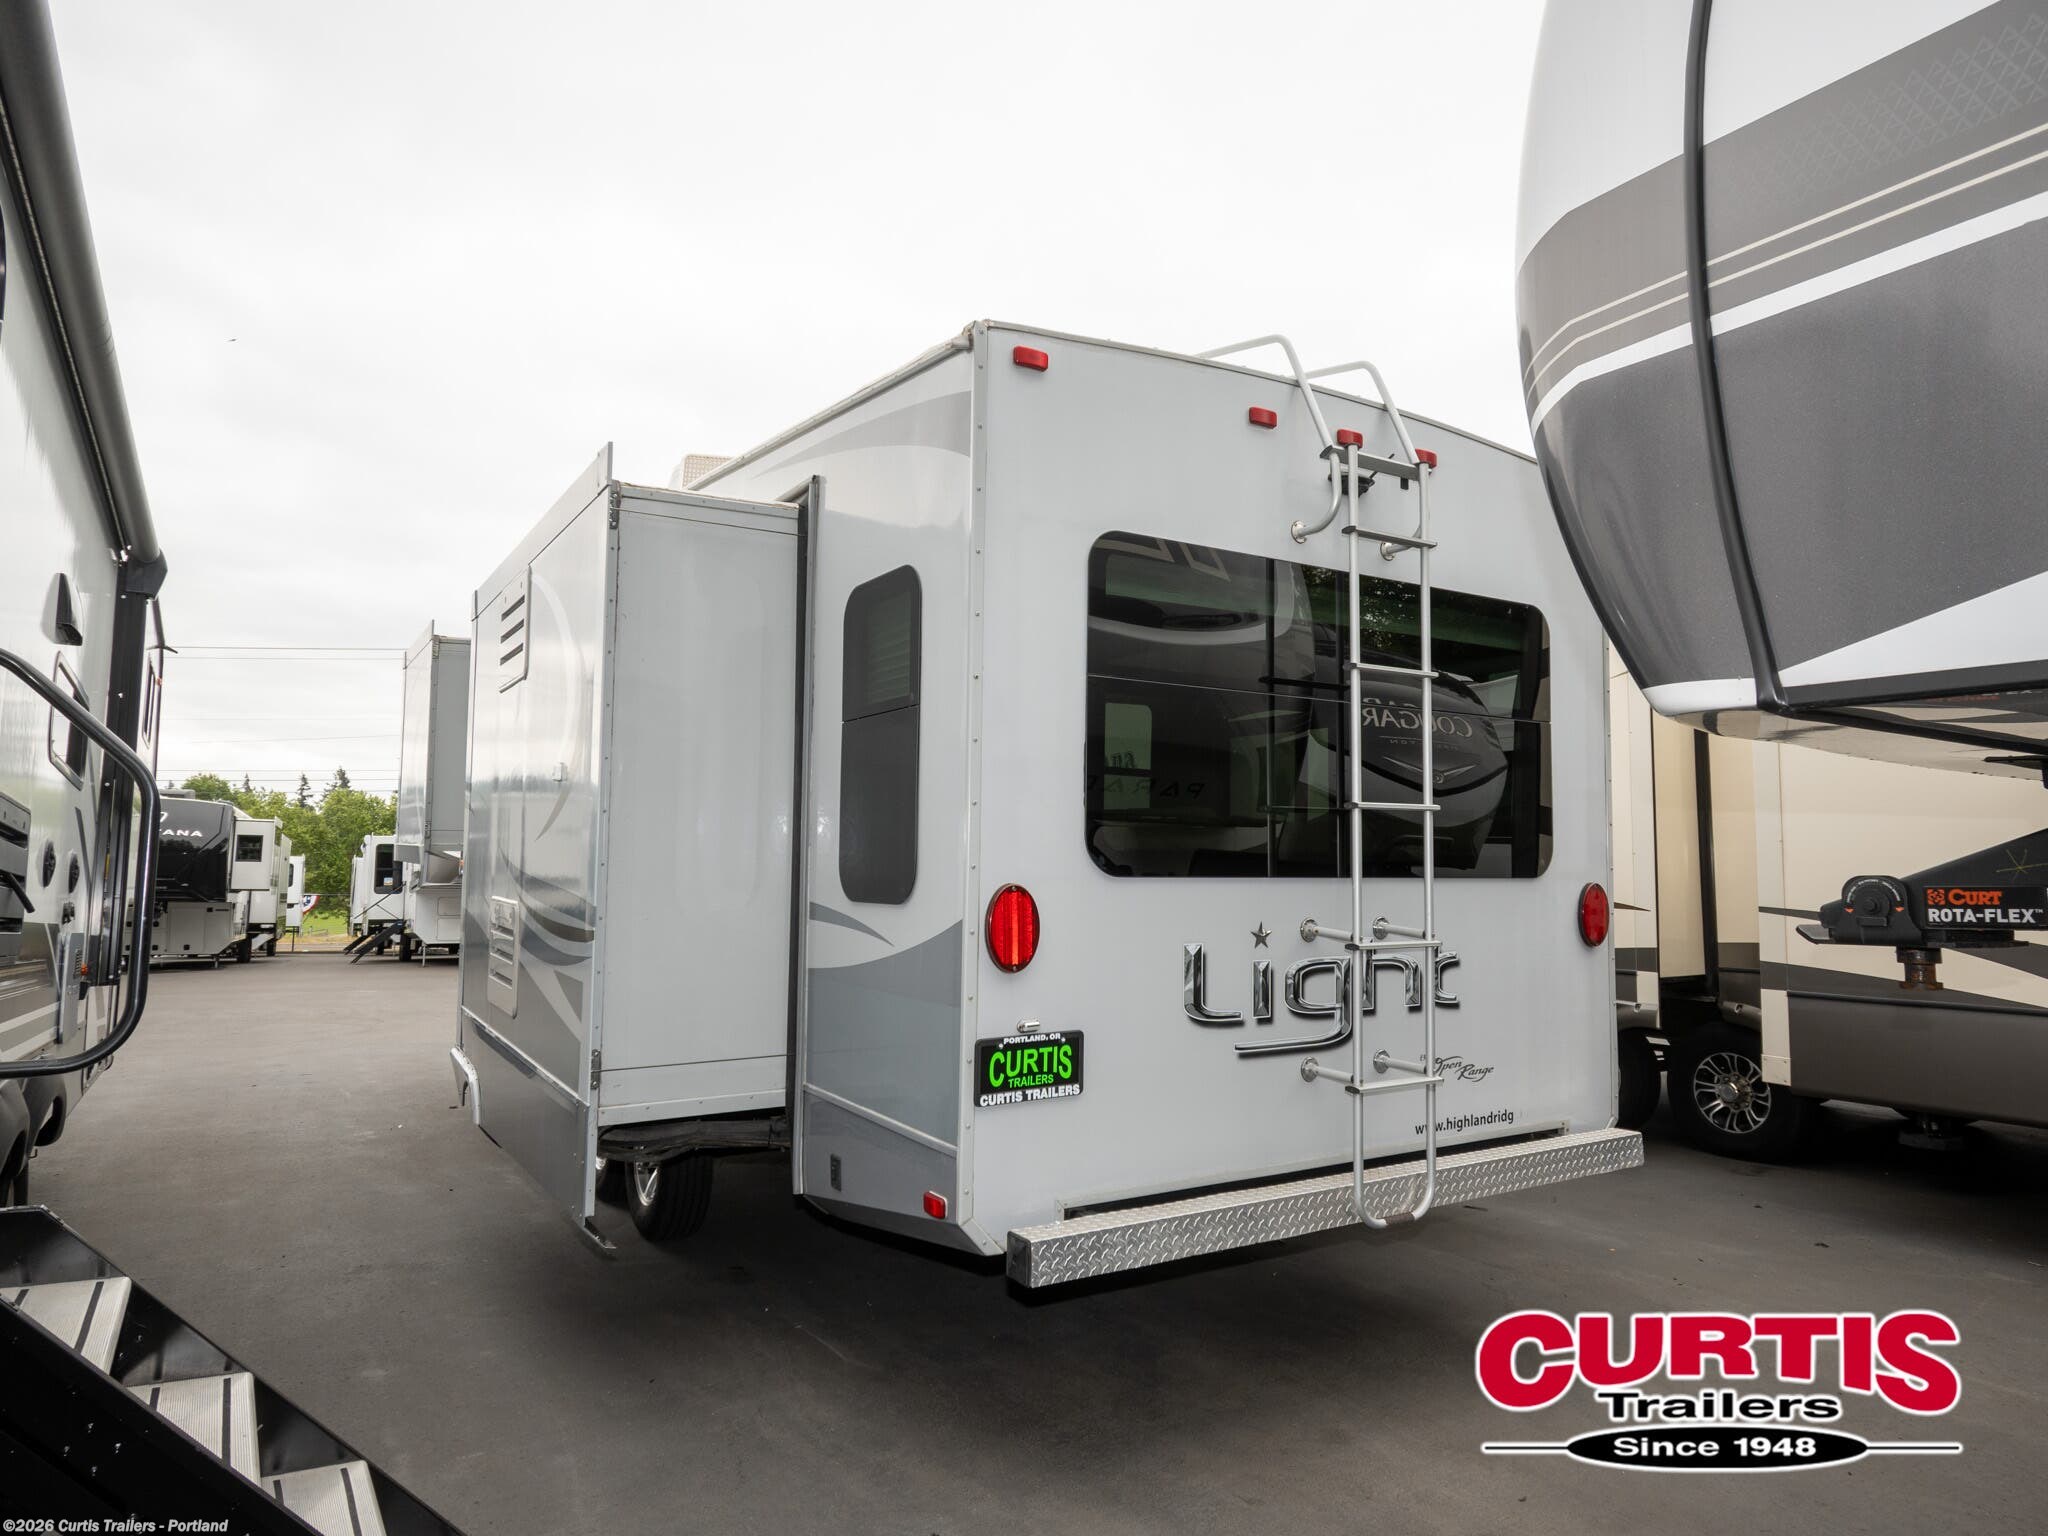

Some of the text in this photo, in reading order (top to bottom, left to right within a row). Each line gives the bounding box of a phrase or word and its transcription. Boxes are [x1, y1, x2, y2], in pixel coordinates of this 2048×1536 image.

[158, 828, 203, 838] ANA
[1948, 889, 2003, 905] CURT
[1003, 1035, 1049, 1045] PORTLAND,
[989, 1044, 1072, 1087] CURTIS
[1455, 1064, 1494, 1082] Range
[1008, 1074, 1054, 1088] TRAILERS
[980, 1084, 1081, 1107] CURTIS TRAILERS
[1415, 1109, 1514, 1135] ww.highlandridg
